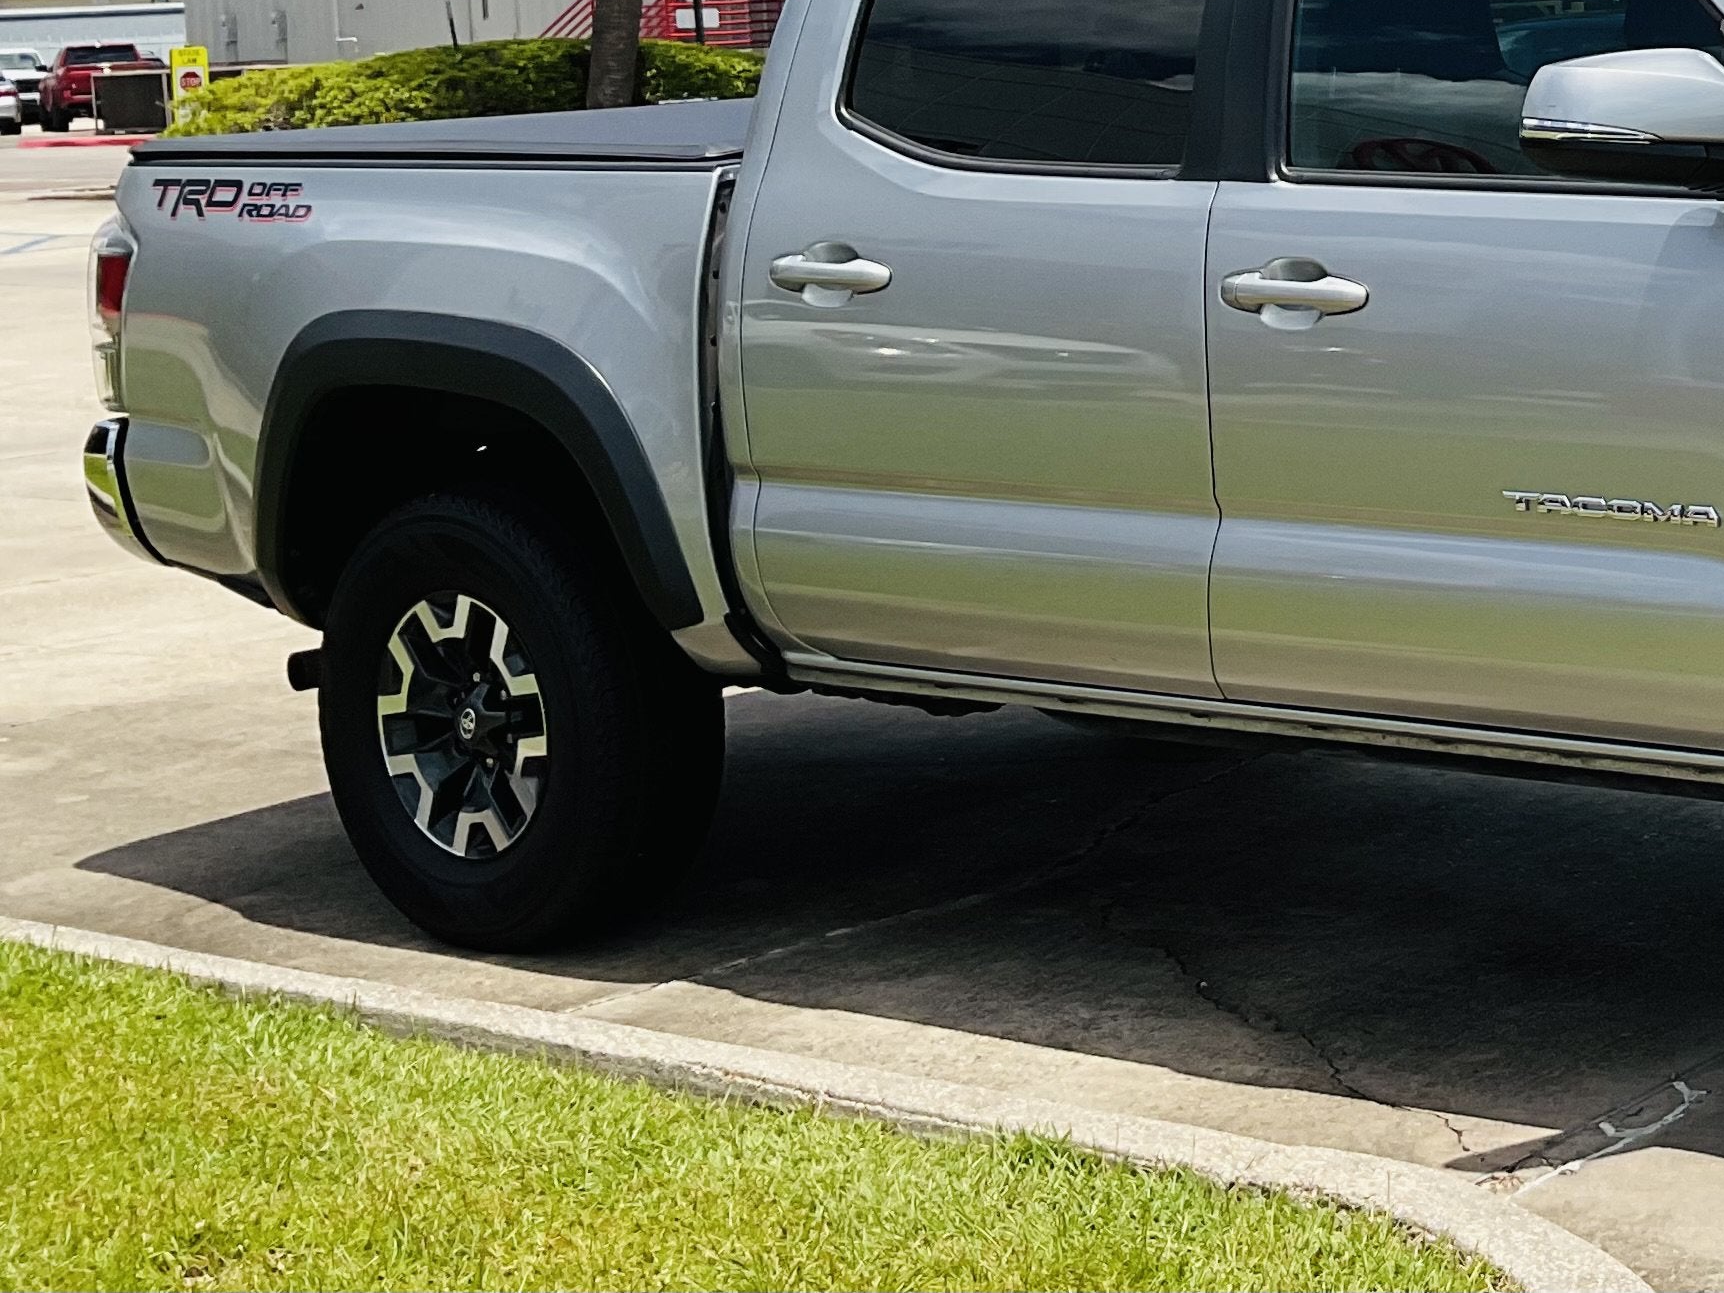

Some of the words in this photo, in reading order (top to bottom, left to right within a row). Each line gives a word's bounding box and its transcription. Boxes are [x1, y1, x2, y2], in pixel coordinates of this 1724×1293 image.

[152, 179, 243, 221] TRD
[247, 182, 304, 201] OFF
[237, 203, 313, 222] ROAD
[1502, 490, 1722, 528] TACOMA
